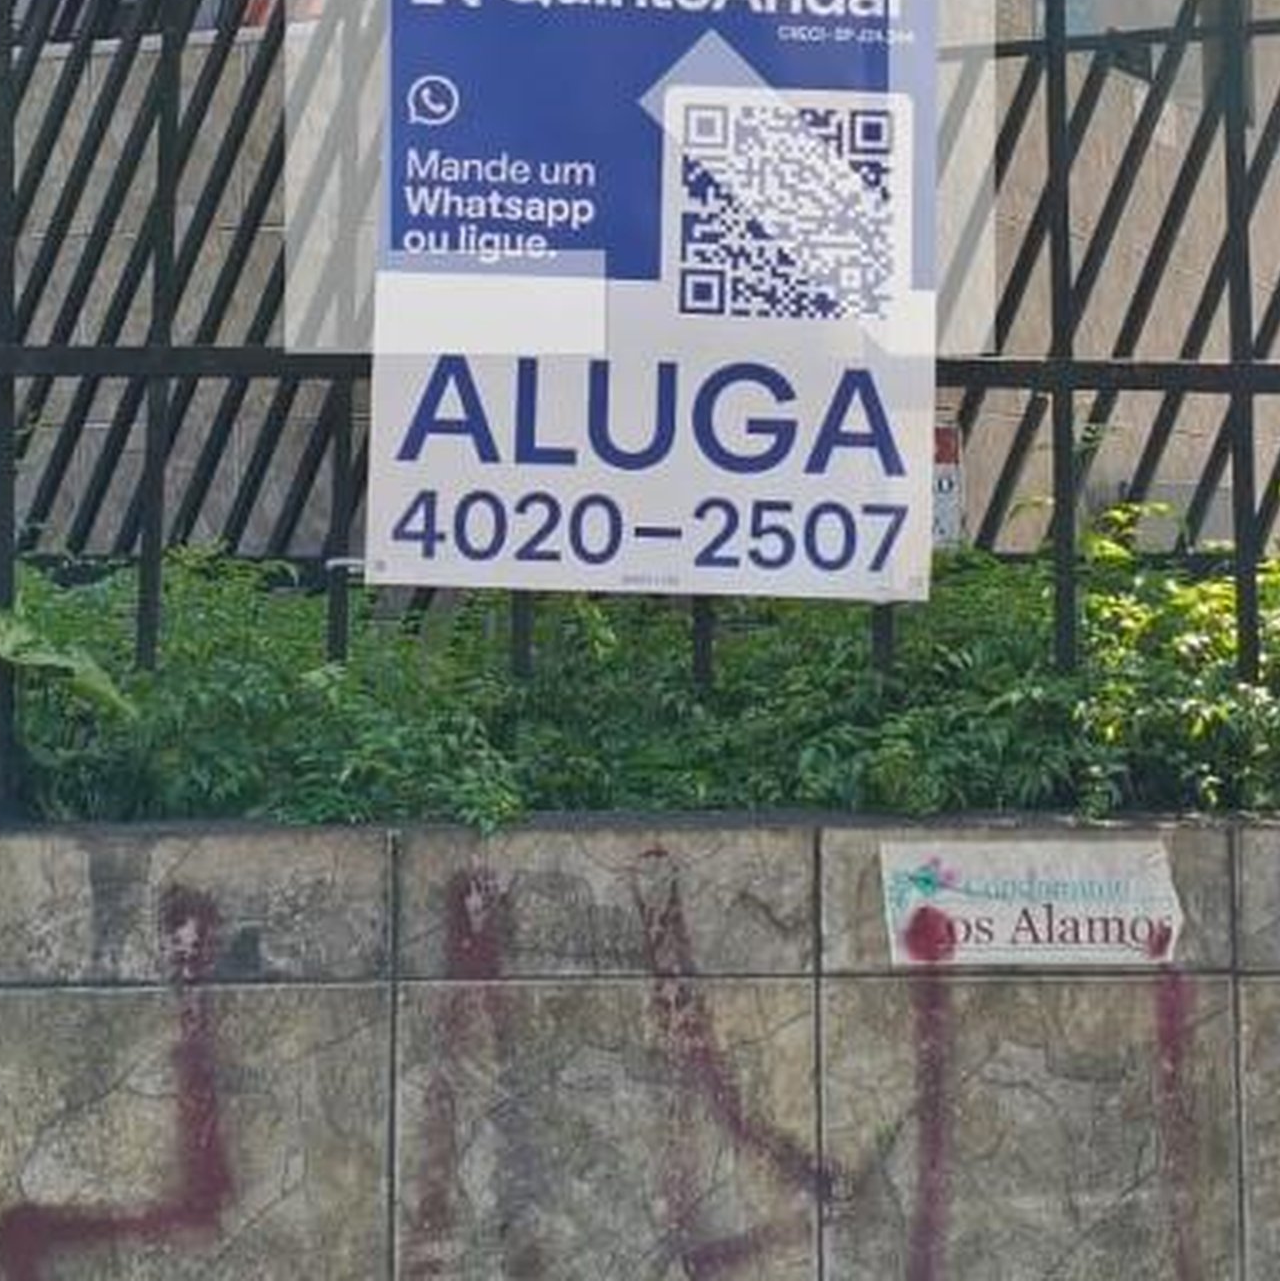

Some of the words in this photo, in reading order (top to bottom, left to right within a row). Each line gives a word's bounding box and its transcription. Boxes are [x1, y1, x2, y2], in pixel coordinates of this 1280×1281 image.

[406, 149, 530, 185] Mande
[539, 160, 595, 186] um
[404, 186, 595, 230] Whatsapp
[403, 229, 449, 256] ou
[459, 224, 558, 263] ligue.
[396, 353, 907, 478] ALUGA
[391, 489, 909, 573] 4020-2507
[930, 908, 994, 945] os
